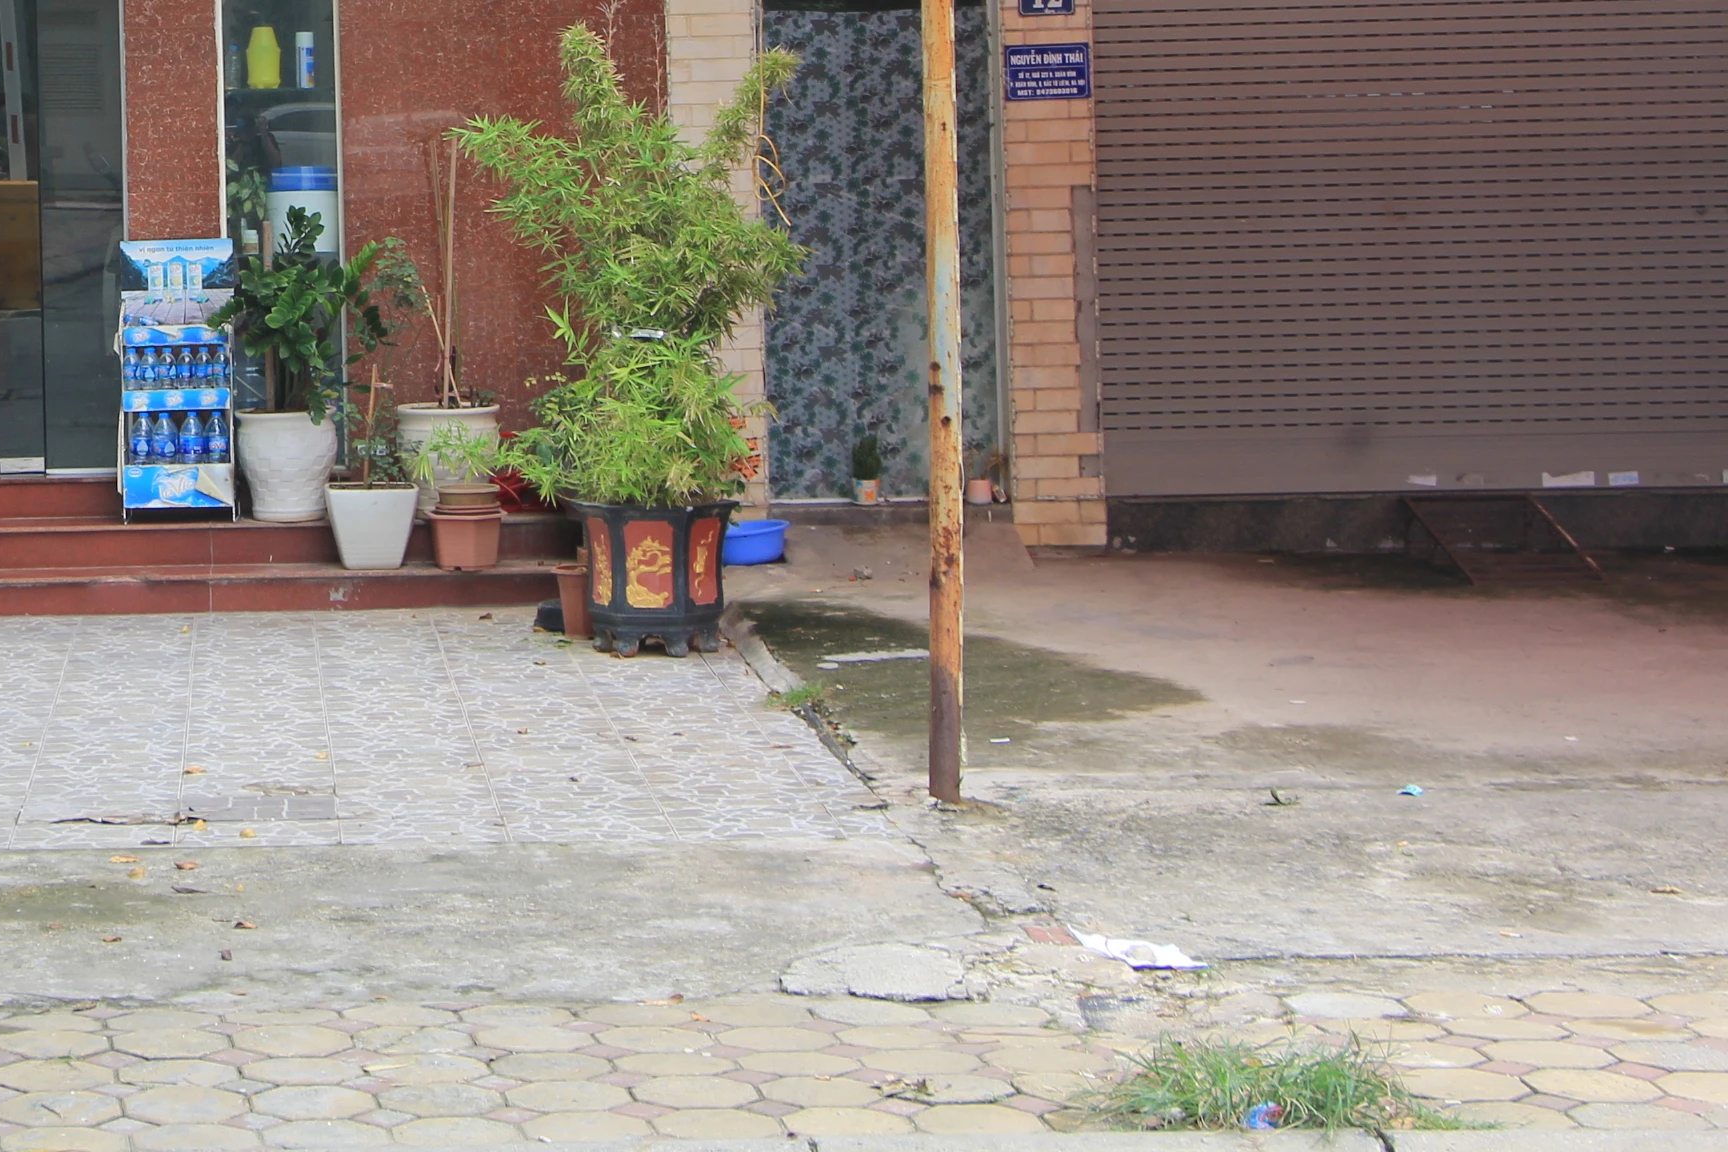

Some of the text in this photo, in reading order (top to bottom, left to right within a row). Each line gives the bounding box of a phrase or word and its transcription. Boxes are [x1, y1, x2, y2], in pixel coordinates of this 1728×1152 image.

[1010, 49, 1084, 66] NGUYỄN ĐÌNH THÁI
